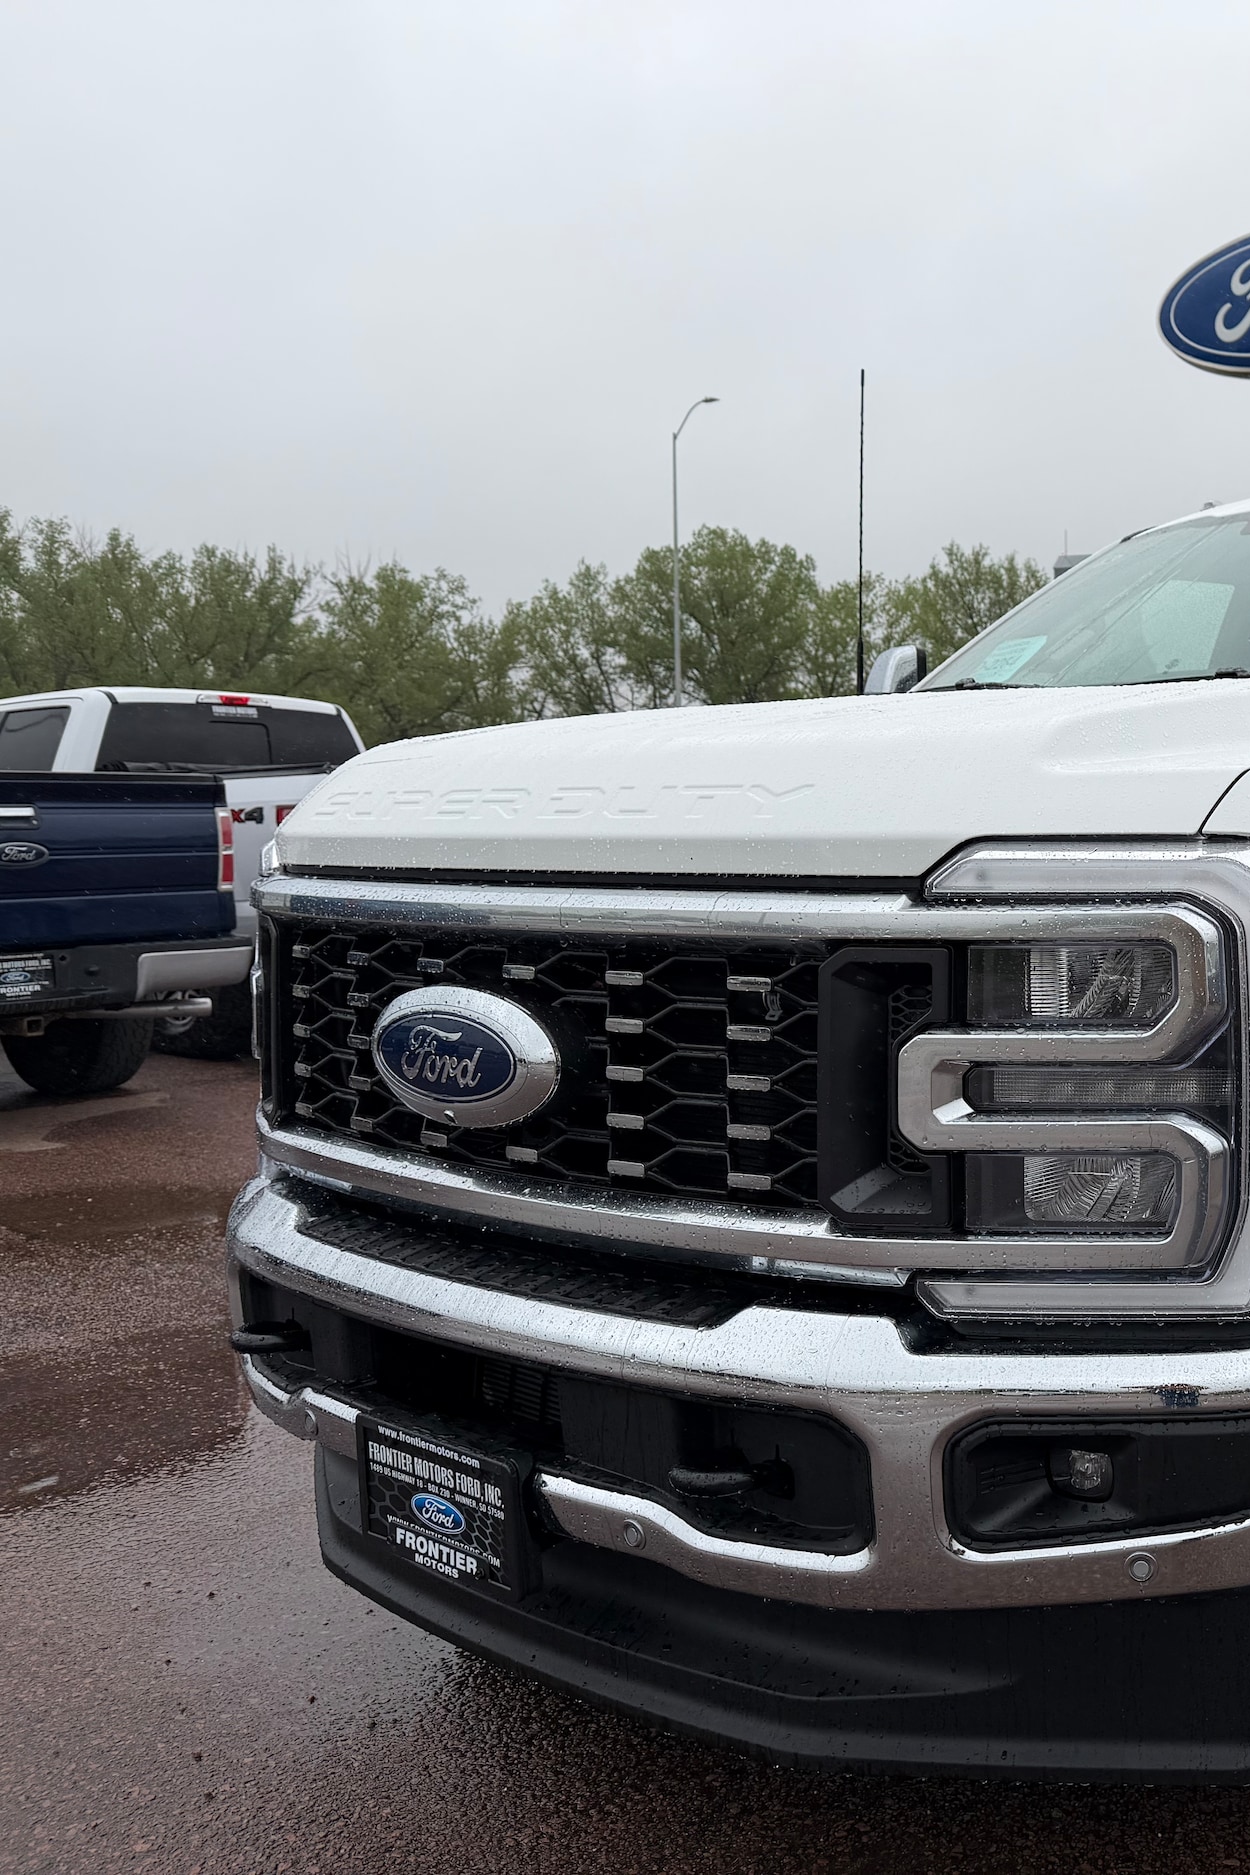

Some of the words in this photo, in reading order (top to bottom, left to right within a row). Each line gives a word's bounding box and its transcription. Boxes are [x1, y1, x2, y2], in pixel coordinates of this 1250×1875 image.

[310, 788, 531, 821] SUPER
[535, 783, 815, 819] DUTY
[1, 846, 36, 861] Ford
[0, 985, 41, 994] RONTIER
[401, 1024, 483, 1088] Ford
[378, 1425, 480, 1469] www.frontiermotors.com
[368, 1441, 413, 1474] FRONTIER
[413, 1457, 455, 1489] MOTORS
[455, 1472, 484, 1502] FORD,
[484, 1483, 505, 1509] INC.
[384, 1467, 392, 1477] US
[392, 1470, 416, 1486] HIGHWAY
[422, 1498, 454, 1528] Ford
[396, 1527, 478, 1576] FRONTIER
[414, 1553, 460, 1579] MOTORS
